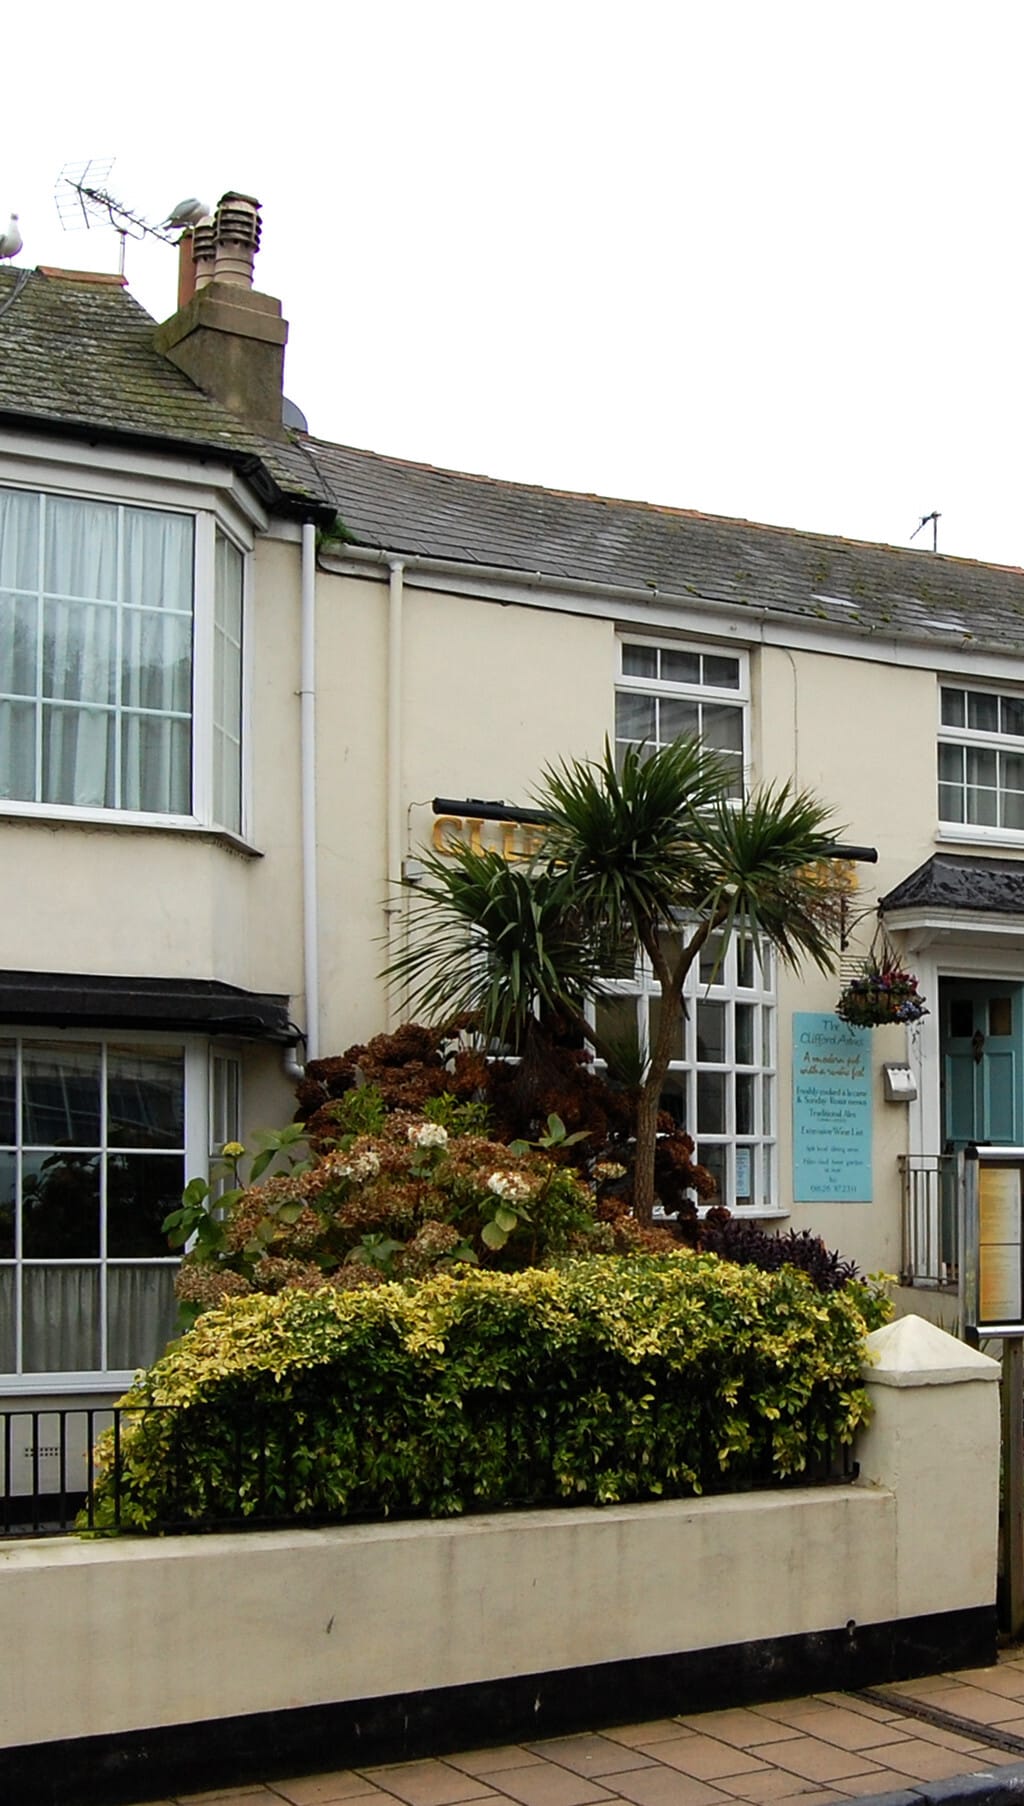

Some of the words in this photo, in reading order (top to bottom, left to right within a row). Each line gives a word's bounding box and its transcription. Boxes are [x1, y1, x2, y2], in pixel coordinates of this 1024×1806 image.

[823, 1020, 839, 1031] The
[800, 1032, 836, 1047] Clifford
[803, 1051, 810, 1063] A
[804, 1096, 826, 1105] Sunday
